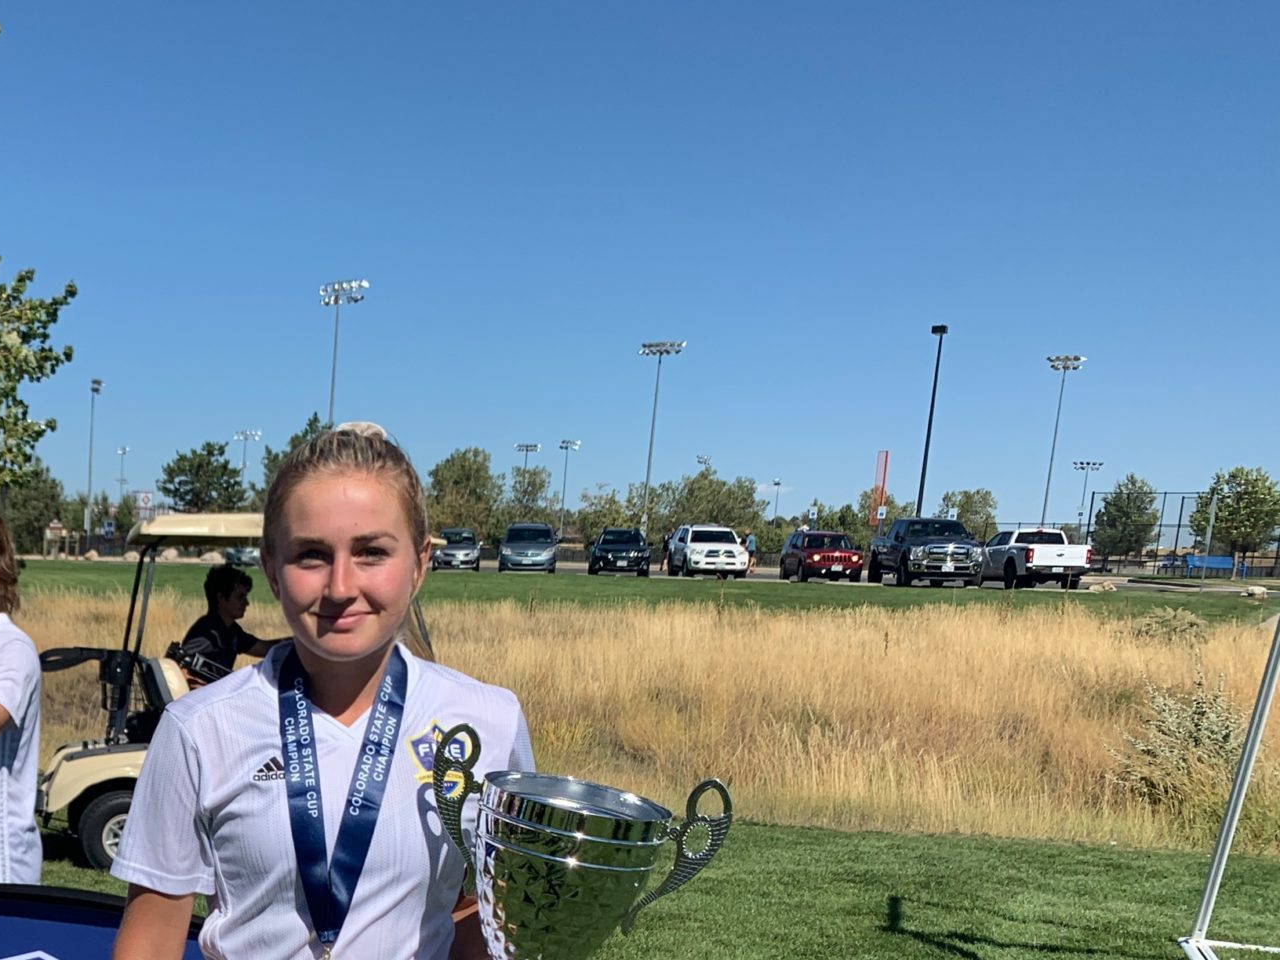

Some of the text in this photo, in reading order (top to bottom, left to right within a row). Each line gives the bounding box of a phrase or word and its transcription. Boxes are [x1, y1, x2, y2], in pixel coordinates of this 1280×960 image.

[253, 770, 286, 781] adida
[284, 717, 301, 782] CHAMPION
[293, 677, 318, 818] COLORADO STATE CUP
[349, 675, 393, 816] COLORADO STATE CUP
[373, 716, 398, 782] CHAMPION
